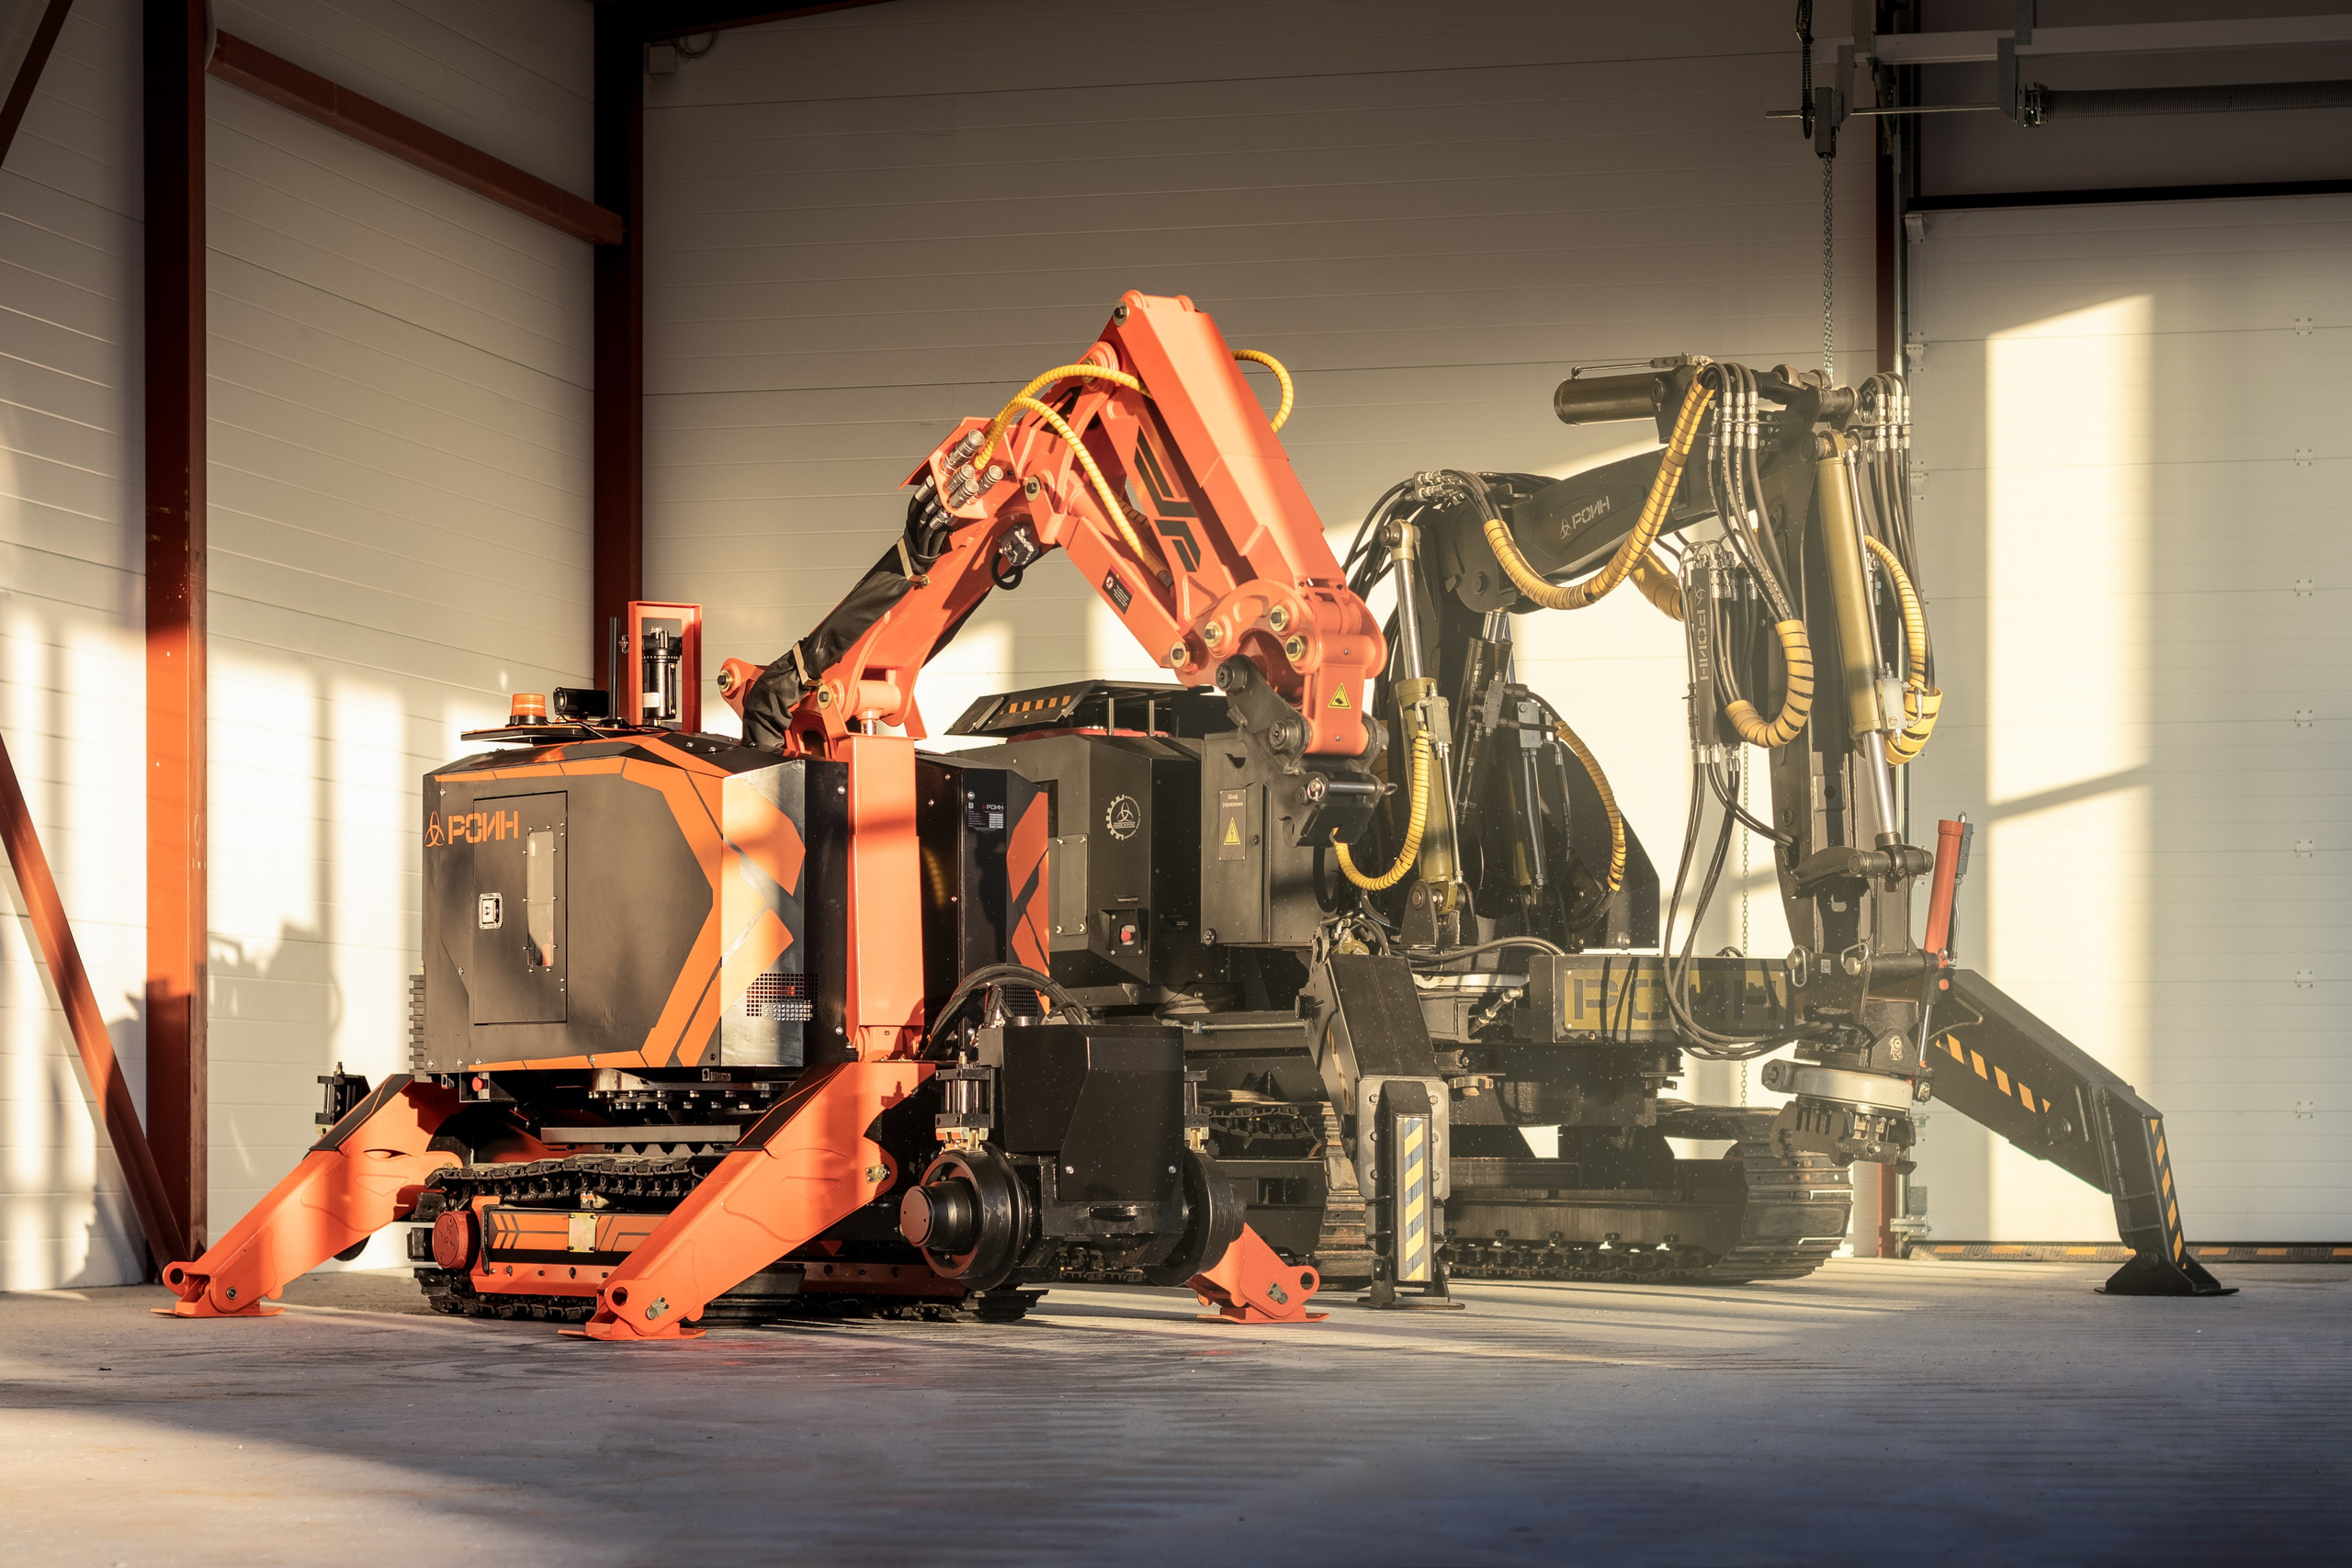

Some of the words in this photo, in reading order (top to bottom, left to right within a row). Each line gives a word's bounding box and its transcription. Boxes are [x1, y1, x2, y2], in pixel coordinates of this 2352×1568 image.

[1572, 496, 1610, 529] РОИН
[1697, 609, 1709, 681] РОИН
[448, 810, 519, 845] РОИН
